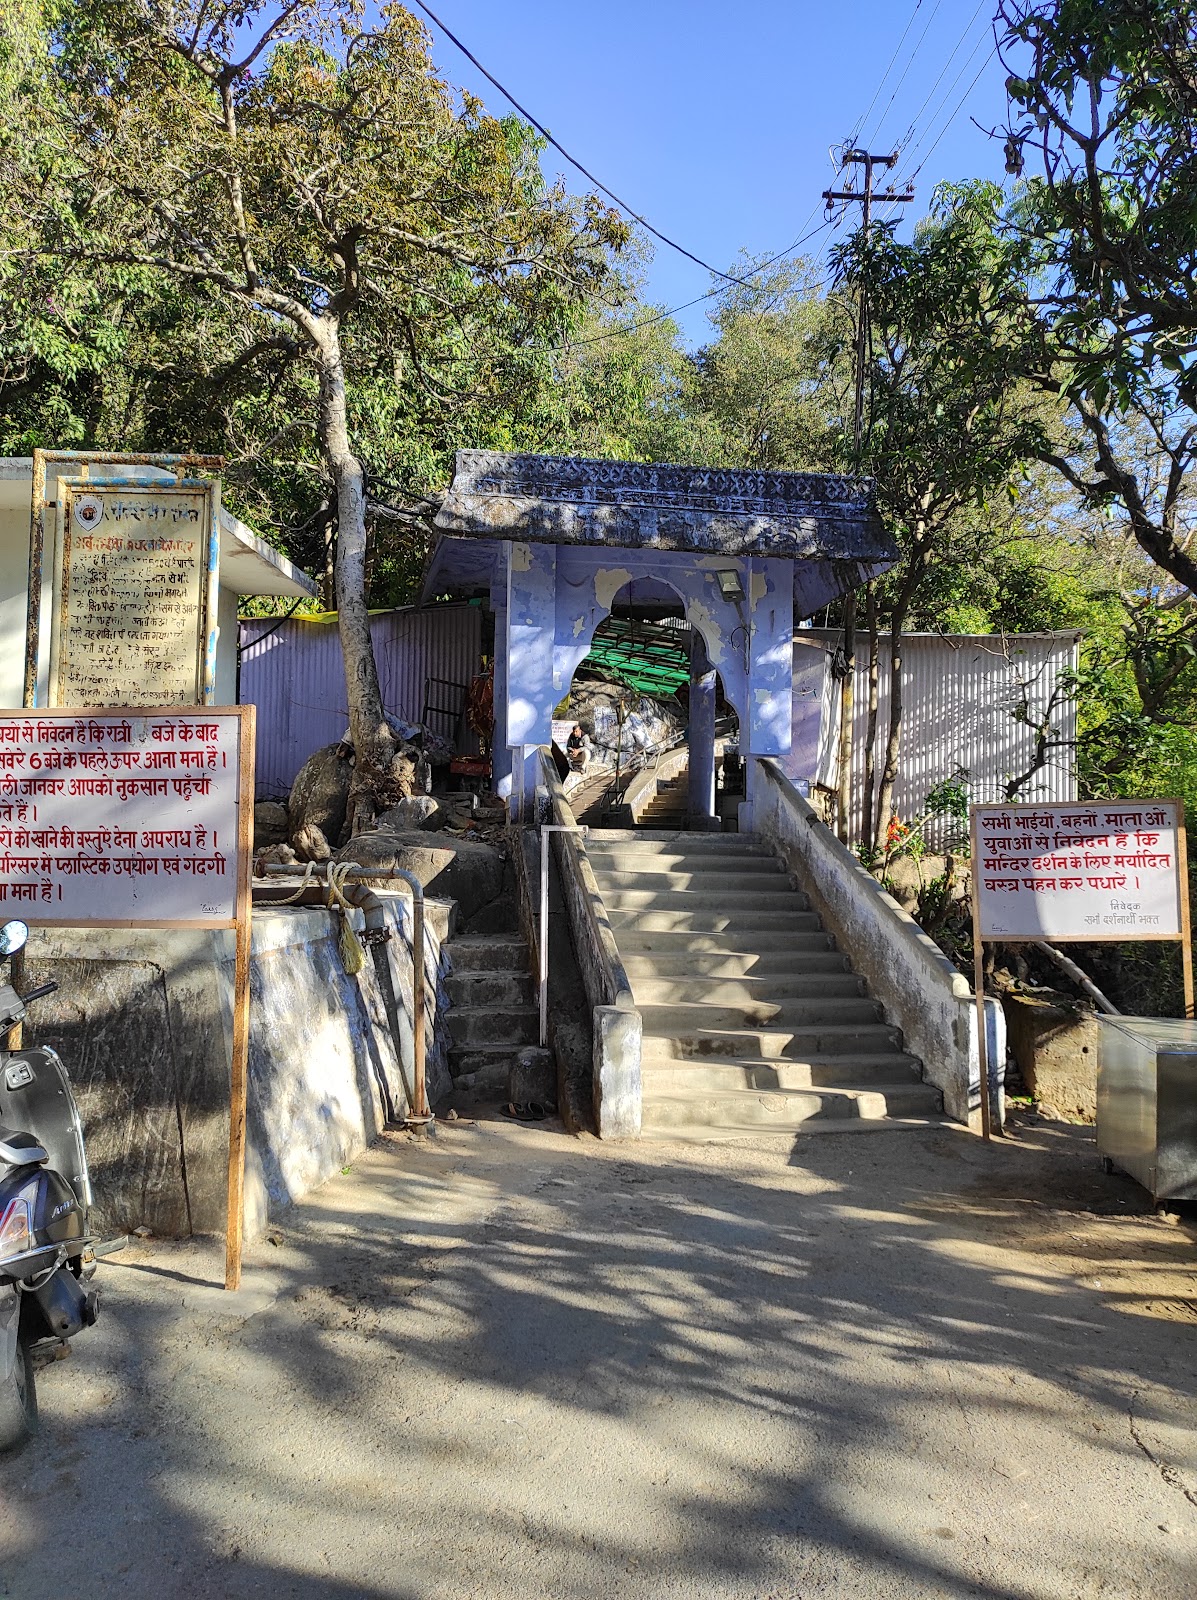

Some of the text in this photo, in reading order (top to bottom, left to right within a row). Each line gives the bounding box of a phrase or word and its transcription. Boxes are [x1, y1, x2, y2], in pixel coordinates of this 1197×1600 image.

[22, 721, 34, 743] से
[37, 721, 74, 744] निवेदन
[77, 720, 87, 745] है
[89, 720, 106, 743] कि
[107, 720, 132, 744] रात्री
[152, 720, 176, 743] बजे
[178, 720, 194, 743] के
[196, 723, 220, 743] बाद
[30, 753, 42, 769] 6
[43, 748, 62, 770] बजे
[63, 747, 77, 769] के
[79, 747, 110, 772] पहले
[110, 752, 140, 769] ऊपर
[144, 751, 176, 769] आना
[180, 752, 204, 769] मना
[20, 779, 65, 796] जानवर
[68, 774, 114, 796] आपको
[116, 778, 168, 800] नुकसान
[982, 812, 1011, 831] सभी
[14, 826, 30, 848] को
[31, 826, 59, 848] खाने
[60, 826, 75, 848] की
[114, 826, 136, 848] देना
[141, 831, 191, 848] अपराध
[983, 829, 1160, 855] युवाओं से निवेदन है कि
[40, 852, 53, 874] में
[55, 852, 110, 875] प्लास्टिक
[113, 852, 159, 875] उपयोग
[163, 854, 180, 875] एवं
[183, 852, 226, 875] गंदगी
[983, 849, 1171, 872] मन्दिर दर्शन के लिए मर्यादित
[11, 883, 38, 901] मना
[984, 878, 1020, 893] वस्त्र
[1021, 877, 1057, 894] पहन
[1059, 877, 1086, 892] कर
[1110, 899, 1141, 911] निवेदक
